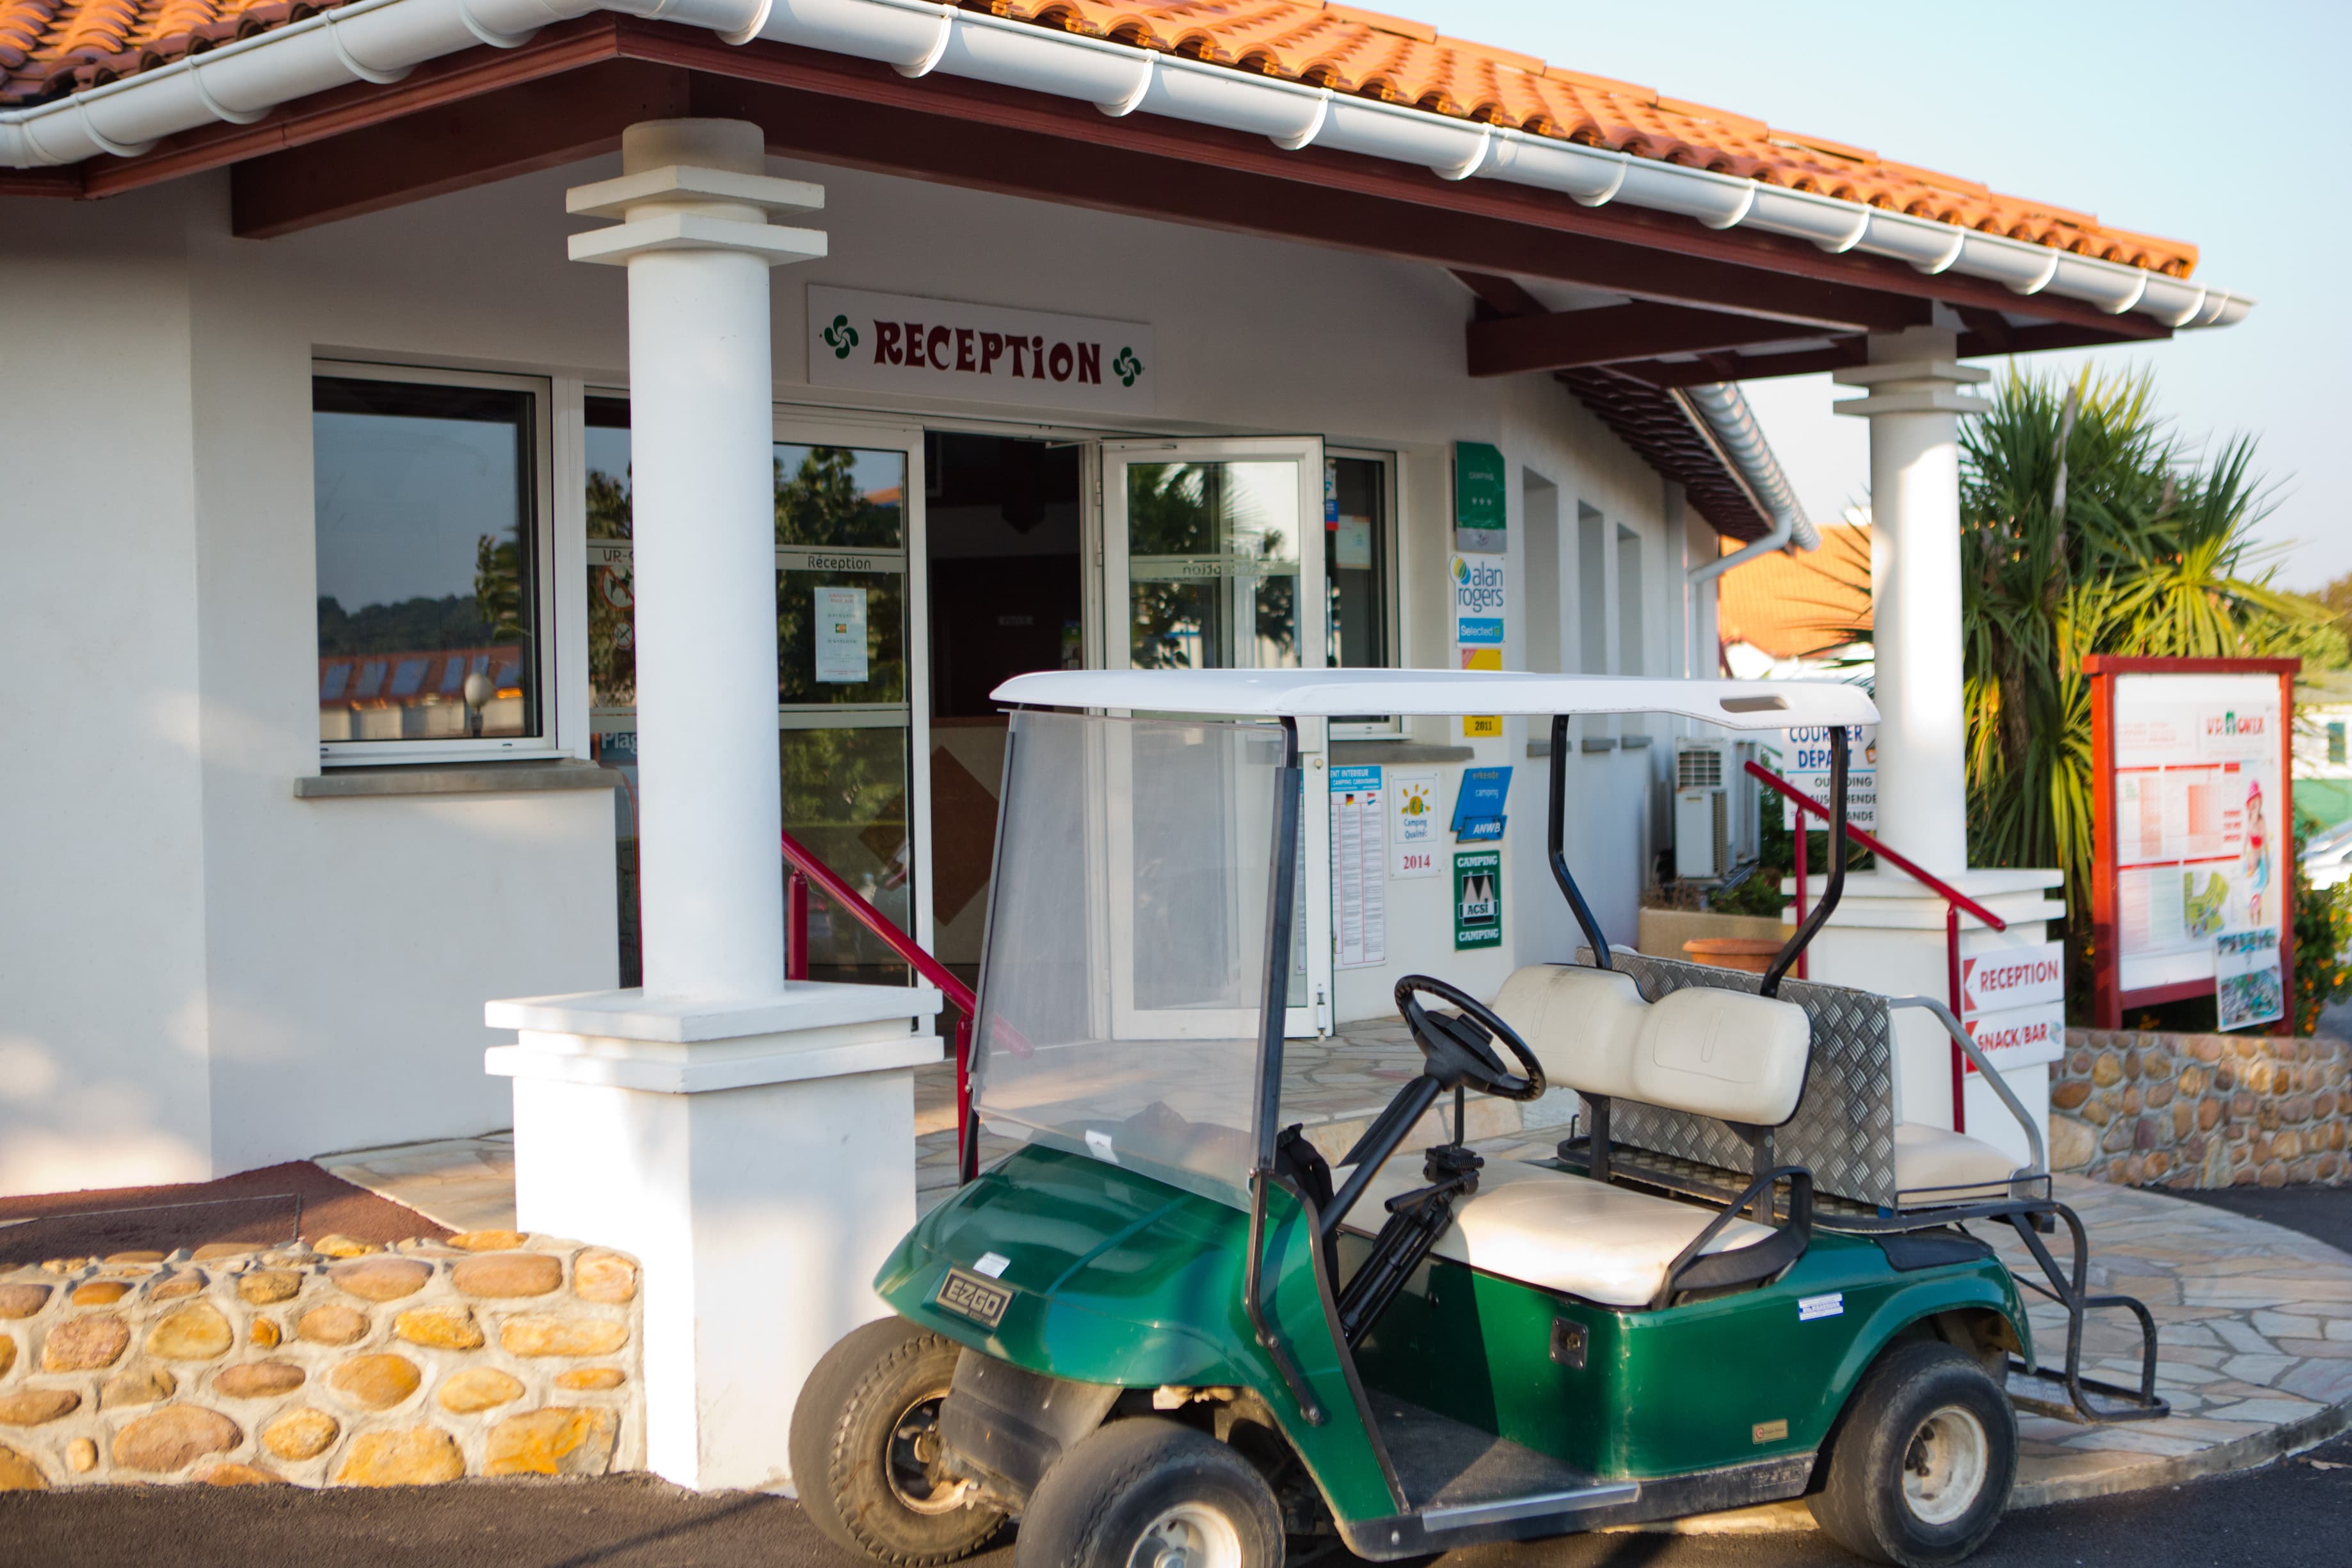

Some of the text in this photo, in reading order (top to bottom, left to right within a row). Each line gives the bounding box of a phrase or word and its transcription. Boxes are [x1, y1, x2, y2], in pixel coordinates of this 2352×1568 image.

[808, 555, 871, 572] Réception
[1472, 561, 1503, 587] alan
[1458, 588, 1504, 613] rogers
[1460, 625, 1493, 636] Selected
[1475, 721, 1492, 731] 2011
[1789, 725, 1863, 742] COURER
[1798, 744, 1853, 769] DÉPAT
[1475, 788, 1499, 799] camping
[1404, 819, 1427, 829] Camping
[1473, 822, 1501, 835] ANWB
[1403, 854, 1430, 870] 2014
[1457, 855, 1498, 868] CAMPING
[1459, 929, 1499, 942] CAMPING
[1980, 960, 2058, 993] RECEPTION
